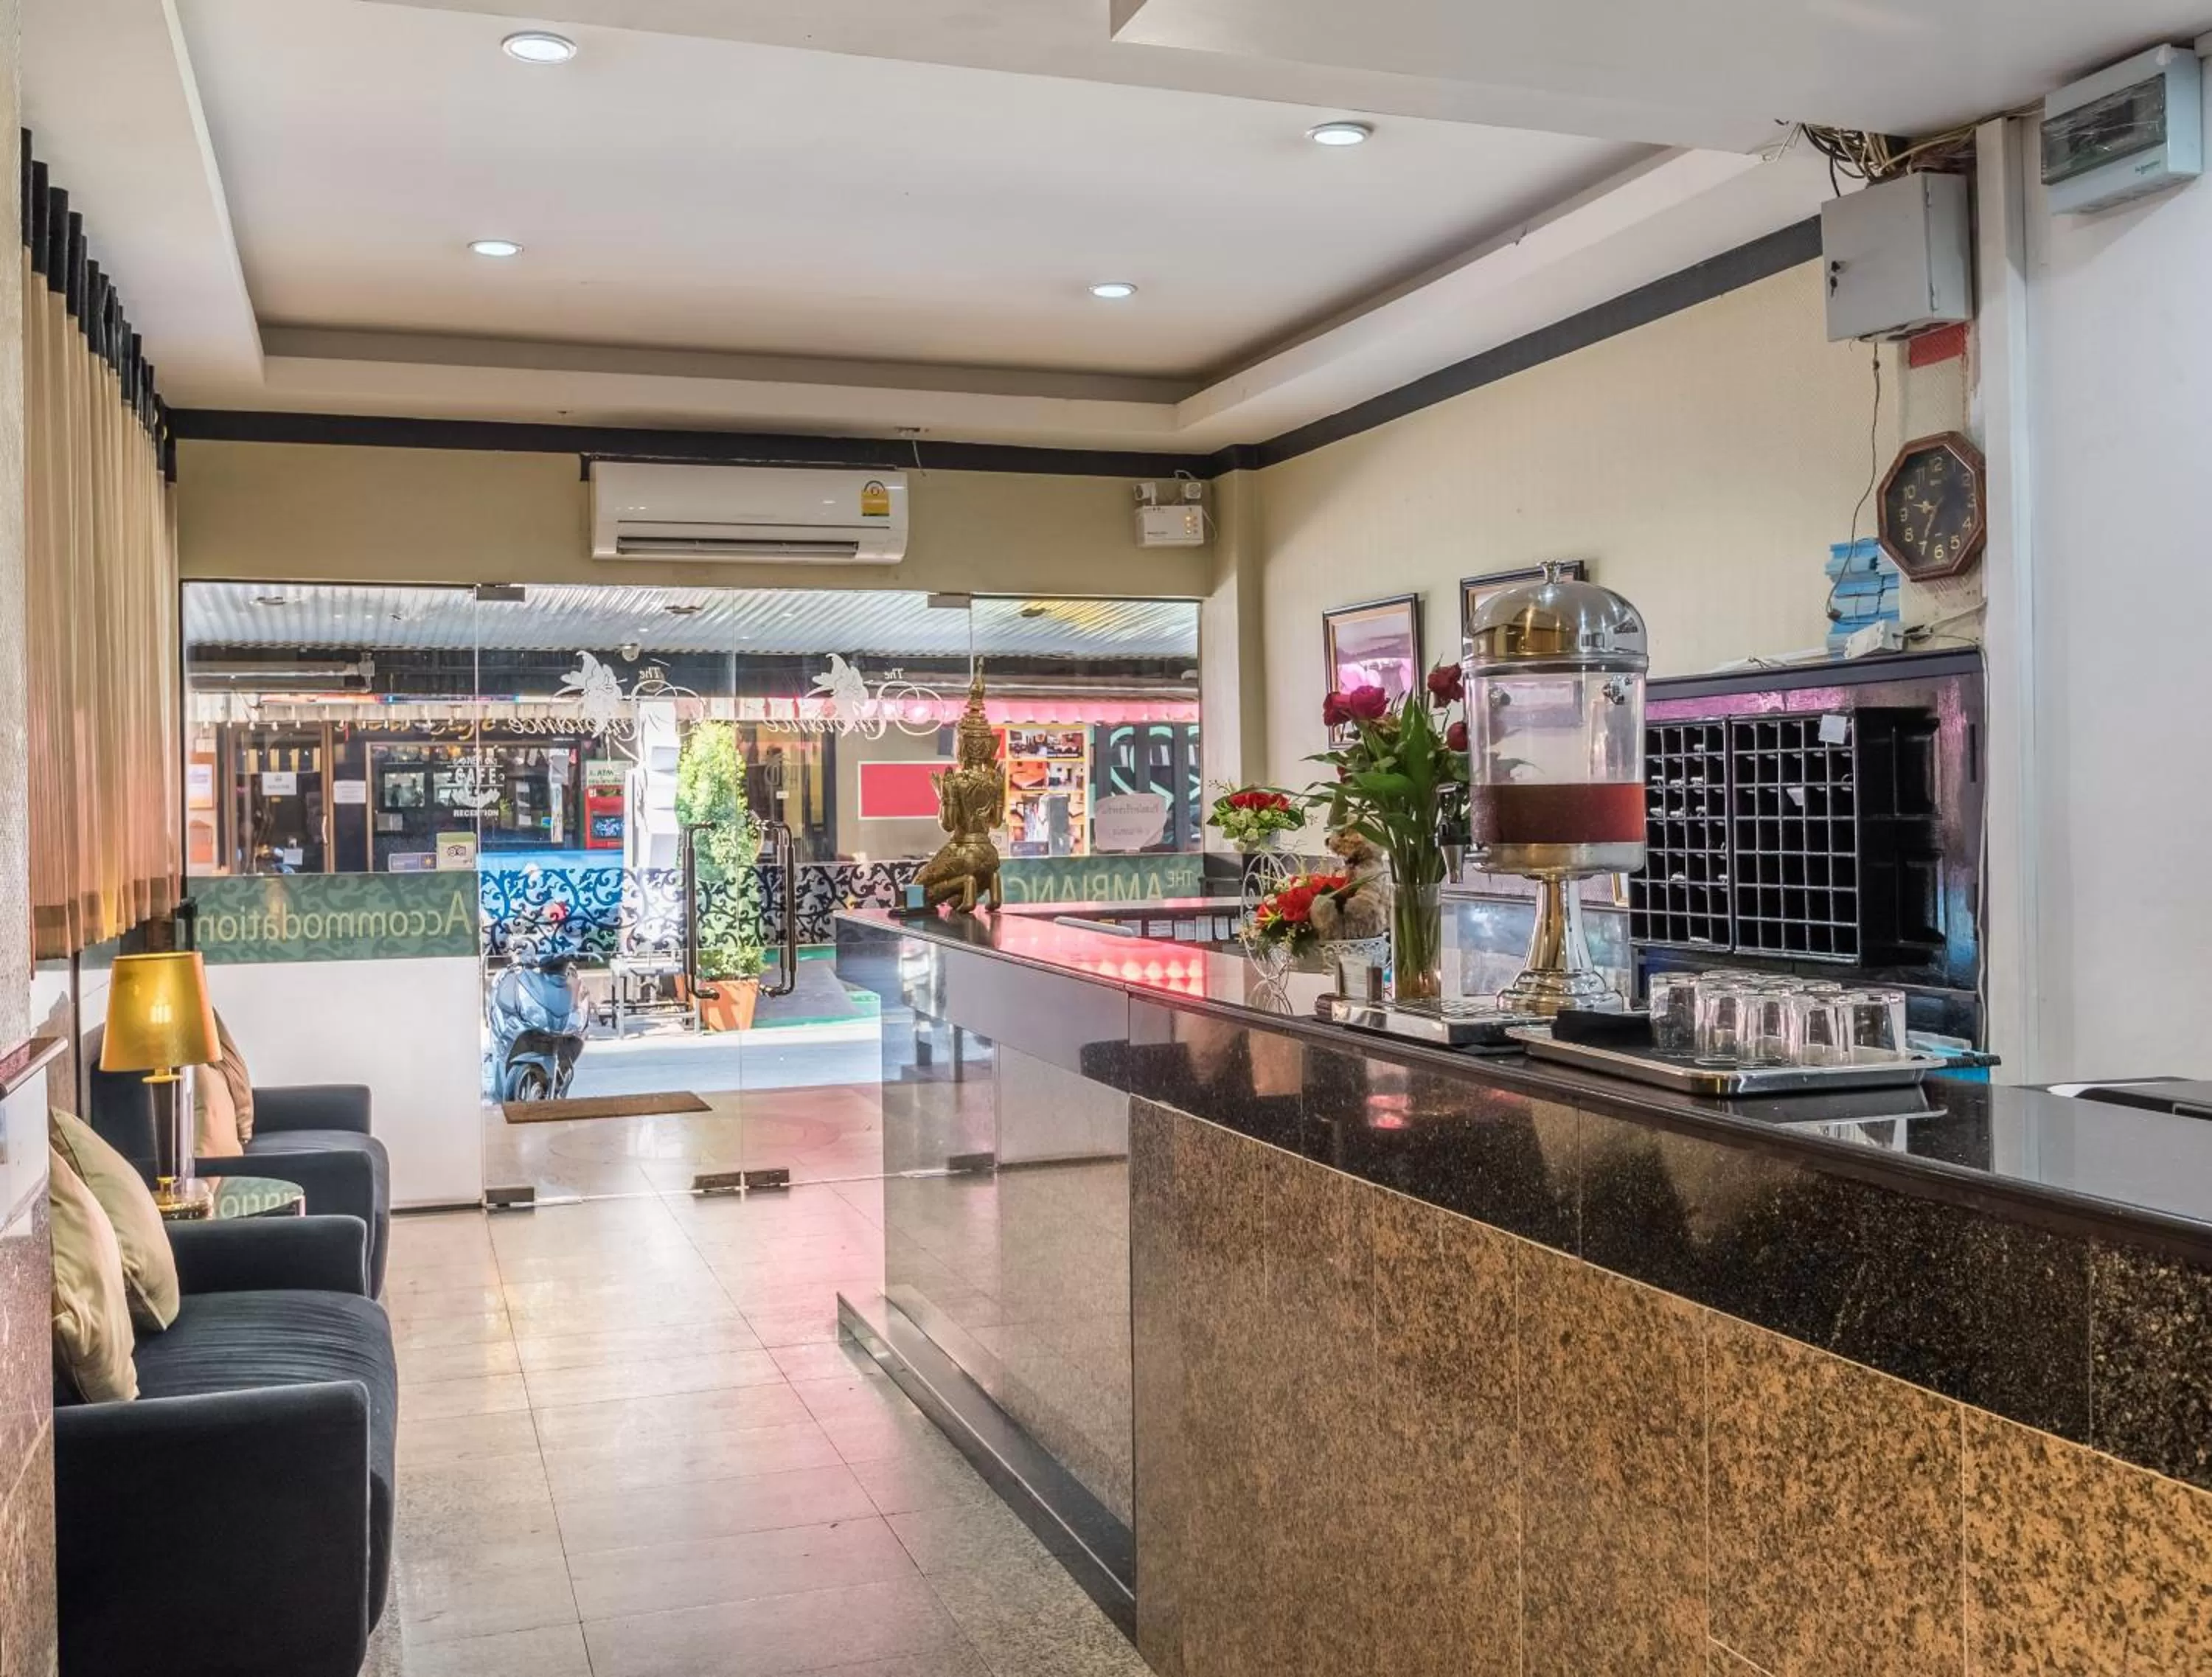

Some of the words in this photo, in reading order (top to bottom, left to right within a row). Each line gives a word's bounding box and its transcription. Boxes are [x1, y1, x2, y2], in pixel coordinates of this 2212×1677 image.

[1962, 515, 1972, 531] 4
[1905, 527, 1914, 542] 8
[1950, 534, 1961, 549] 5
[1918, 540, 1928, 556] 7
[1934, 544, 1944, 560] 6
